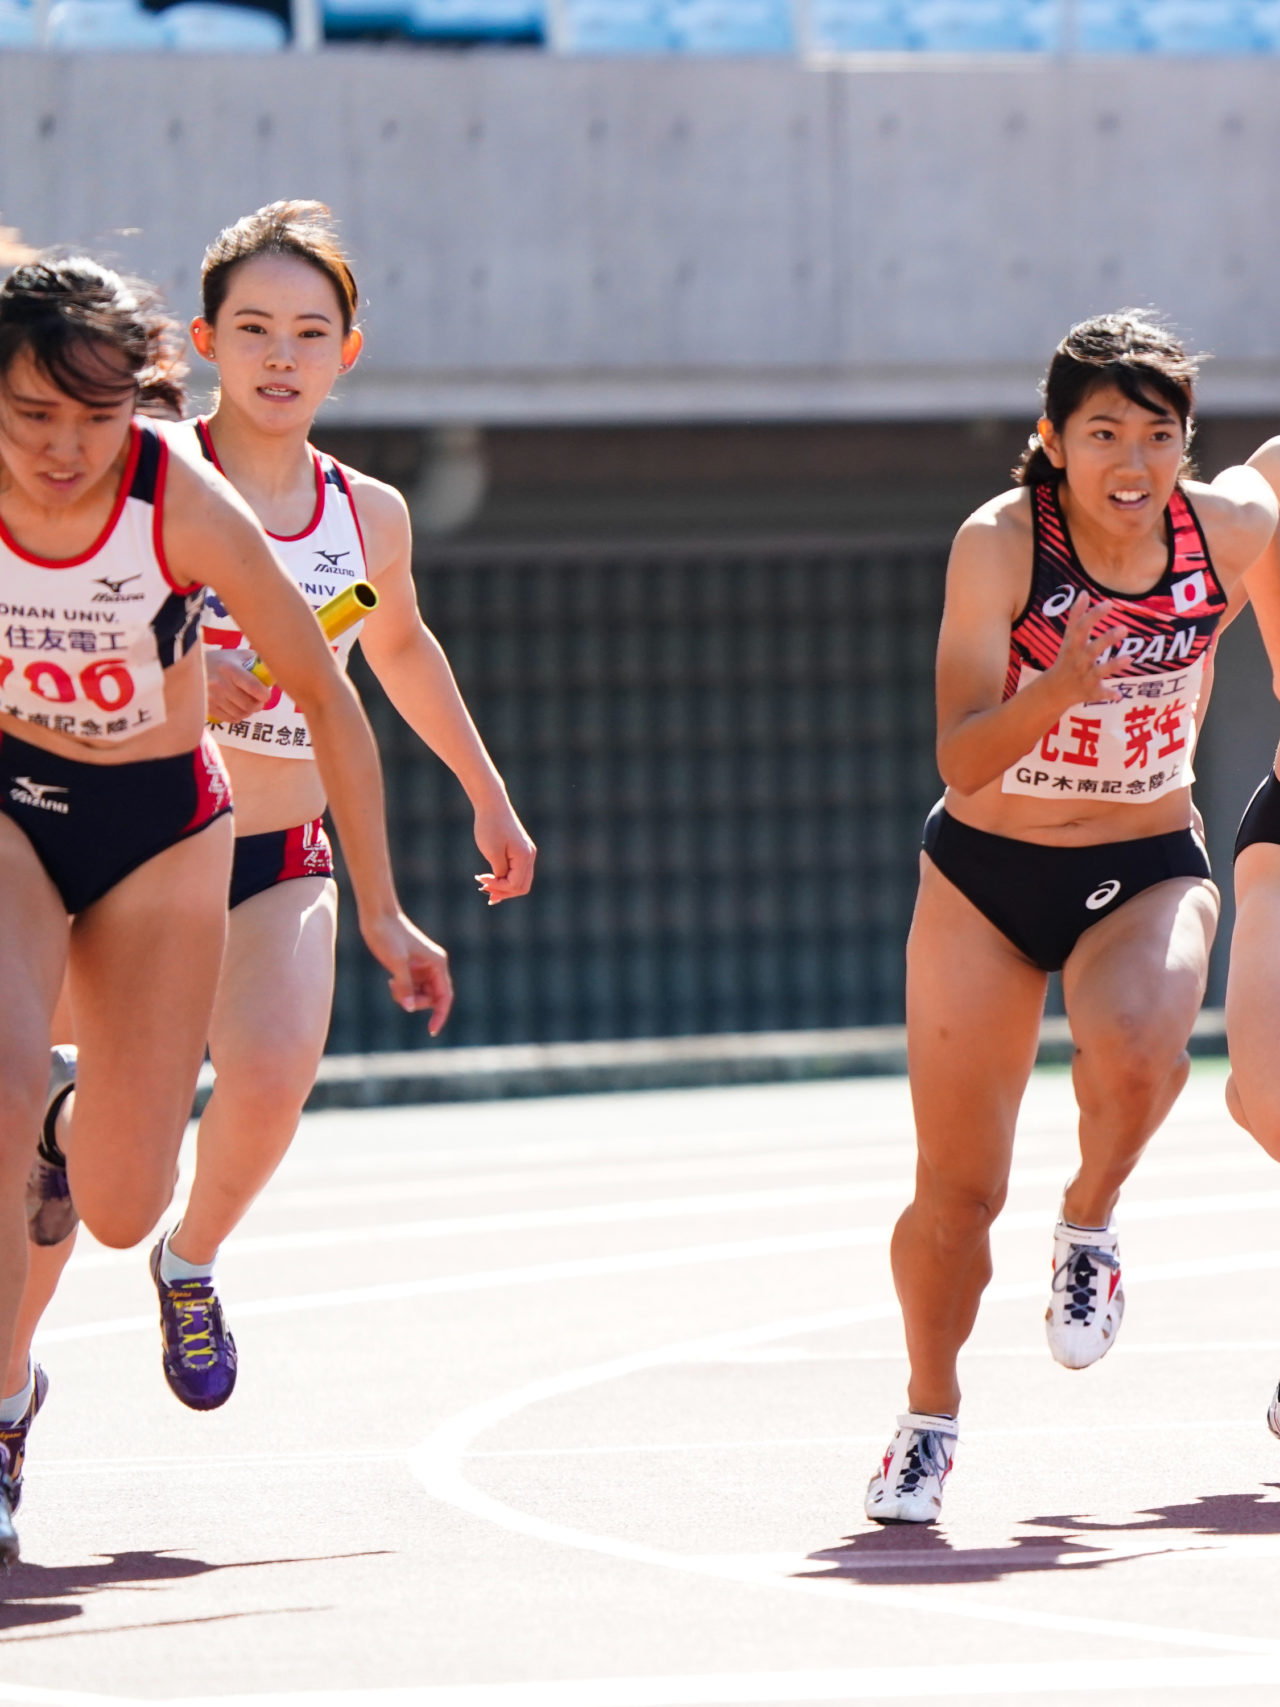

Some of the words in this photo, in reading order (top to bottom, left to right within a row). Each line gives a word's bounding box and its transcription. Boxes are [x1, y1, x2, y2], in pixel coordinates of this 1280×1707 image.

[300, 582, 336, 597] NIV
[5, 624, 128, 653] 住友電工
[1083, 674, 1188, 708] 友電工
[1124, 698, 1186, 769] 芽生
[1015, 763, 1180, 795] GP木南記念陸上
